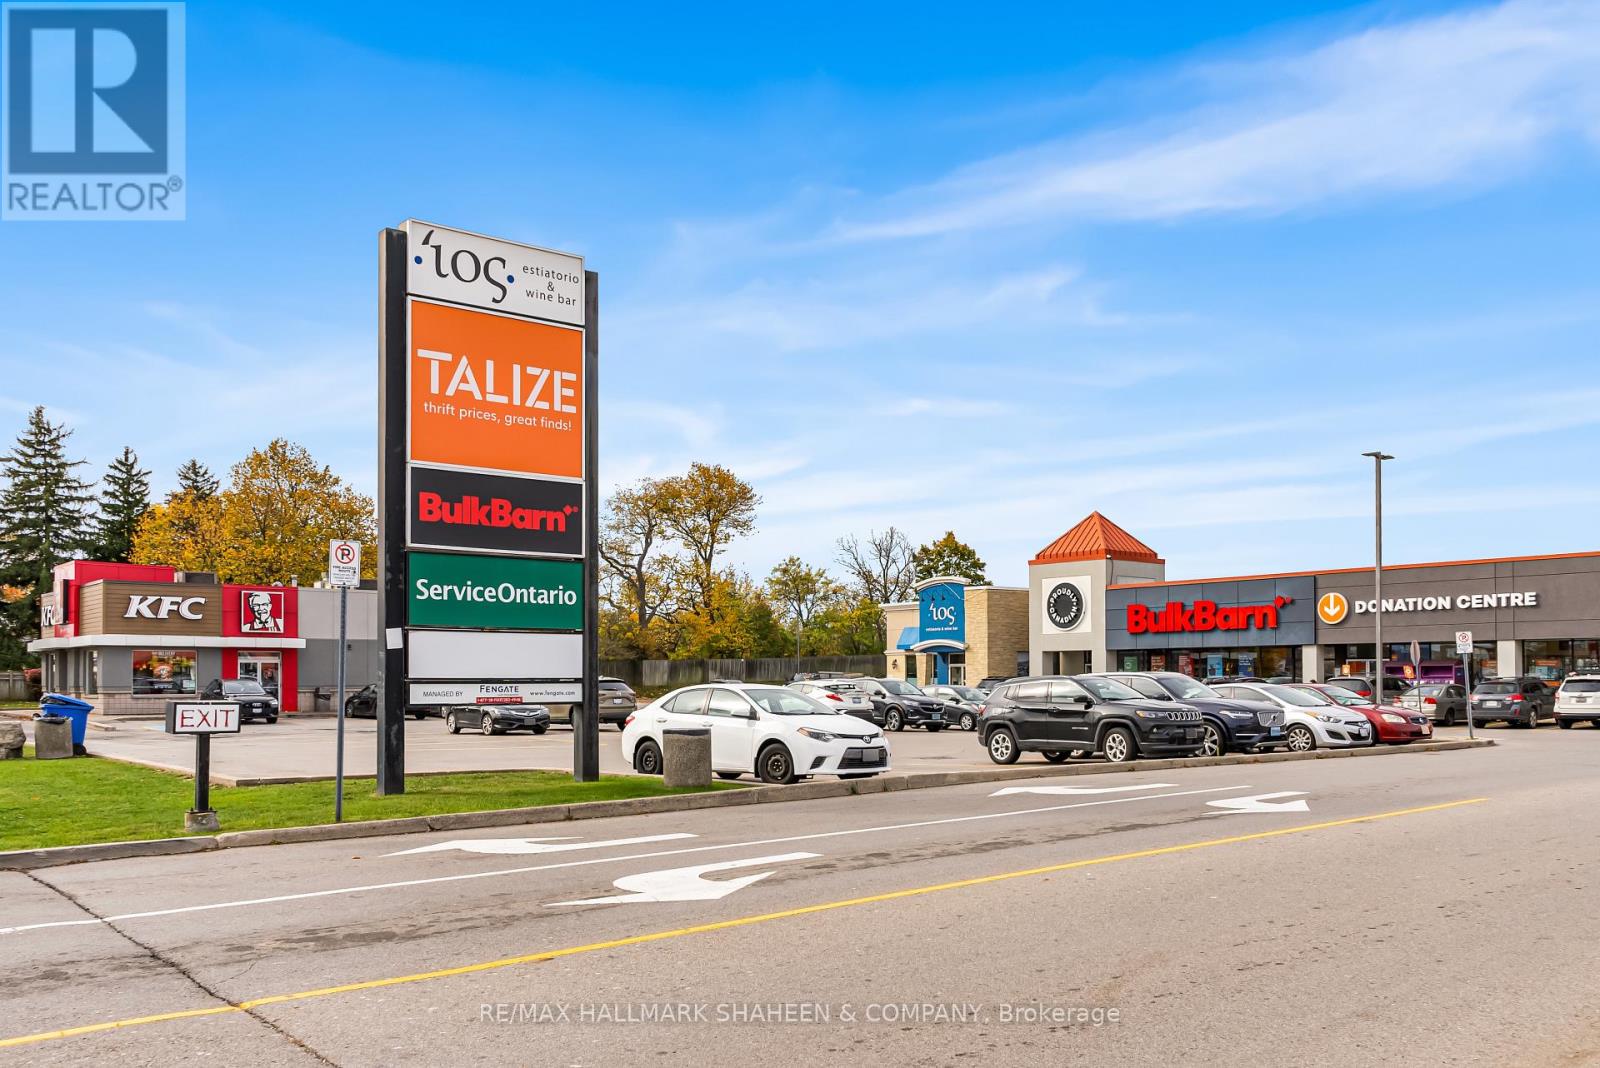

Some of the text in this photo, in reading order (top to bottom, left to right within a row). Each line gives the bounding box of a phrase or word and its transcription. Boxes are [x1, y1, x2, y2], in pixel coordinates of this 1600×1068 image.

[522, 265, 579, 284] estiatorio
[547, 281, 555, 292] &
[526, 289, 576, 306] wine bar
[417, 348, 577, 413] TALIZE
[423, 401, 572, 432] thrift prices, great finds!
[418, 491, 566, 532] BulkBarn
[415, 578, 577, 606] ServiceOntario
[1049, 587, 1078, 604] PROUDLY
[123, 595, 206, 620] KFC
[1354, 592, 1537, 614] DONATION CENTRE
[1049, 607, 1078, 624] CANADIAN
[1127, 600, 1277, 633] BulkBarn
[479, 685, 519, 693] FENGATE
[181, 709, 235, 728] EXIT
